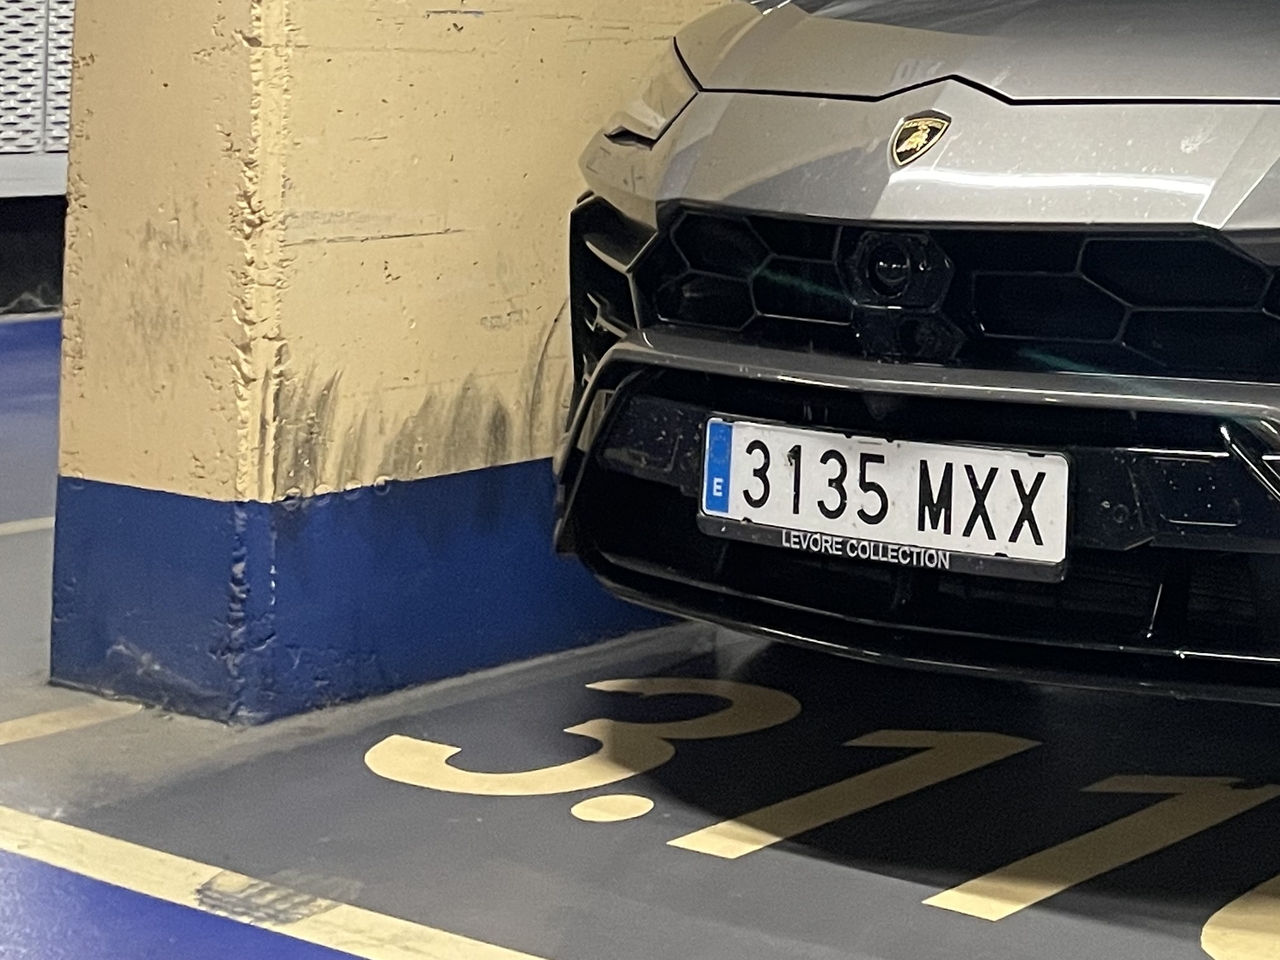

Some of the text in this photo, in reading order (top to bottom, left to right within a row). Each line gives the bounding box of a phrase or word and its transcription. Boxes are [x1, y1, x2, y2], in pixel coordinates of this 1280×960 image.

[713, 477, 723, 497] E
[742, 439, 1046, 546] 3135 MXX
[781, 529, 950, 570] LEVORE COLLECTION
